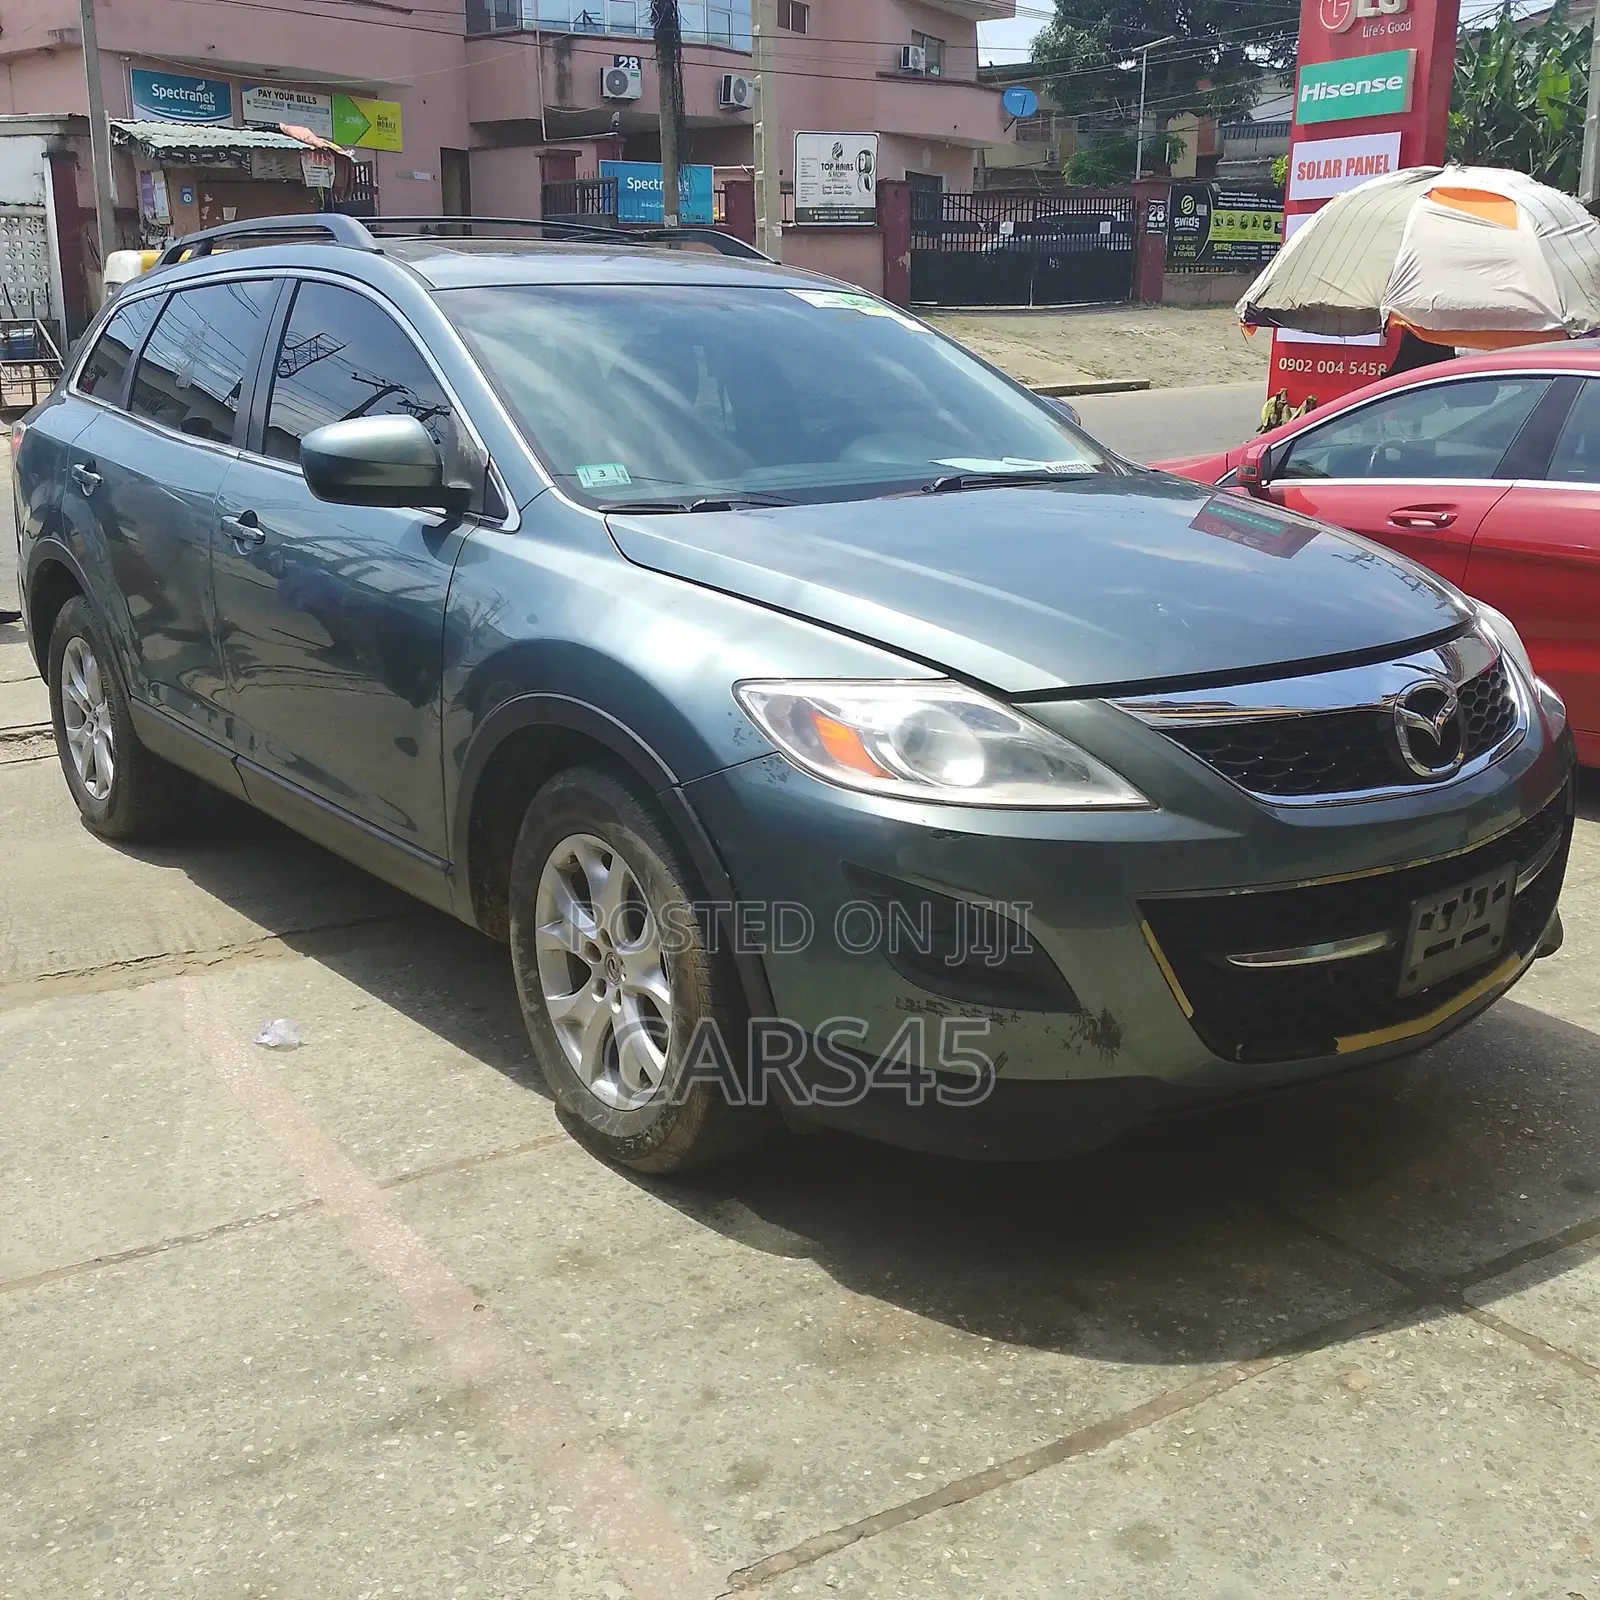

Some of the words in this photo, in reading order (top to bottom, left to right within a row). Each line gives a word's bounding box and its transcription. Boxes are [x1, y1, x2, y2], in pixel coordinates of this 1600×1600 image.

[1362, 24, 1385, 38] Life's
[1387, 18, 1412, 34] Good
[618, 56, 639, 70] 28
[151, 83, 215, 104] Spectranet
[258, 89, 272, 99] PAY
[274, 91, 295, 102] YOUR
[296, 95, 317, 105] BILLS
[1301, 76, 1403, 102] Hisense
[821, 162, 834, 171] TOP
[835, 163, 854, 171] HAIRS
[1297, 159, 1342, 181] SOLAR
[1346, 154, 1390, 177] PANEL
[1148, 204, 1166, 222] 28
[1279, 357, 1313, 373] 0902
[1316, 360, 1345, 375] 004
[1349, 361, 1388, 377] 5458
[598, 469, 606, 478] 3
